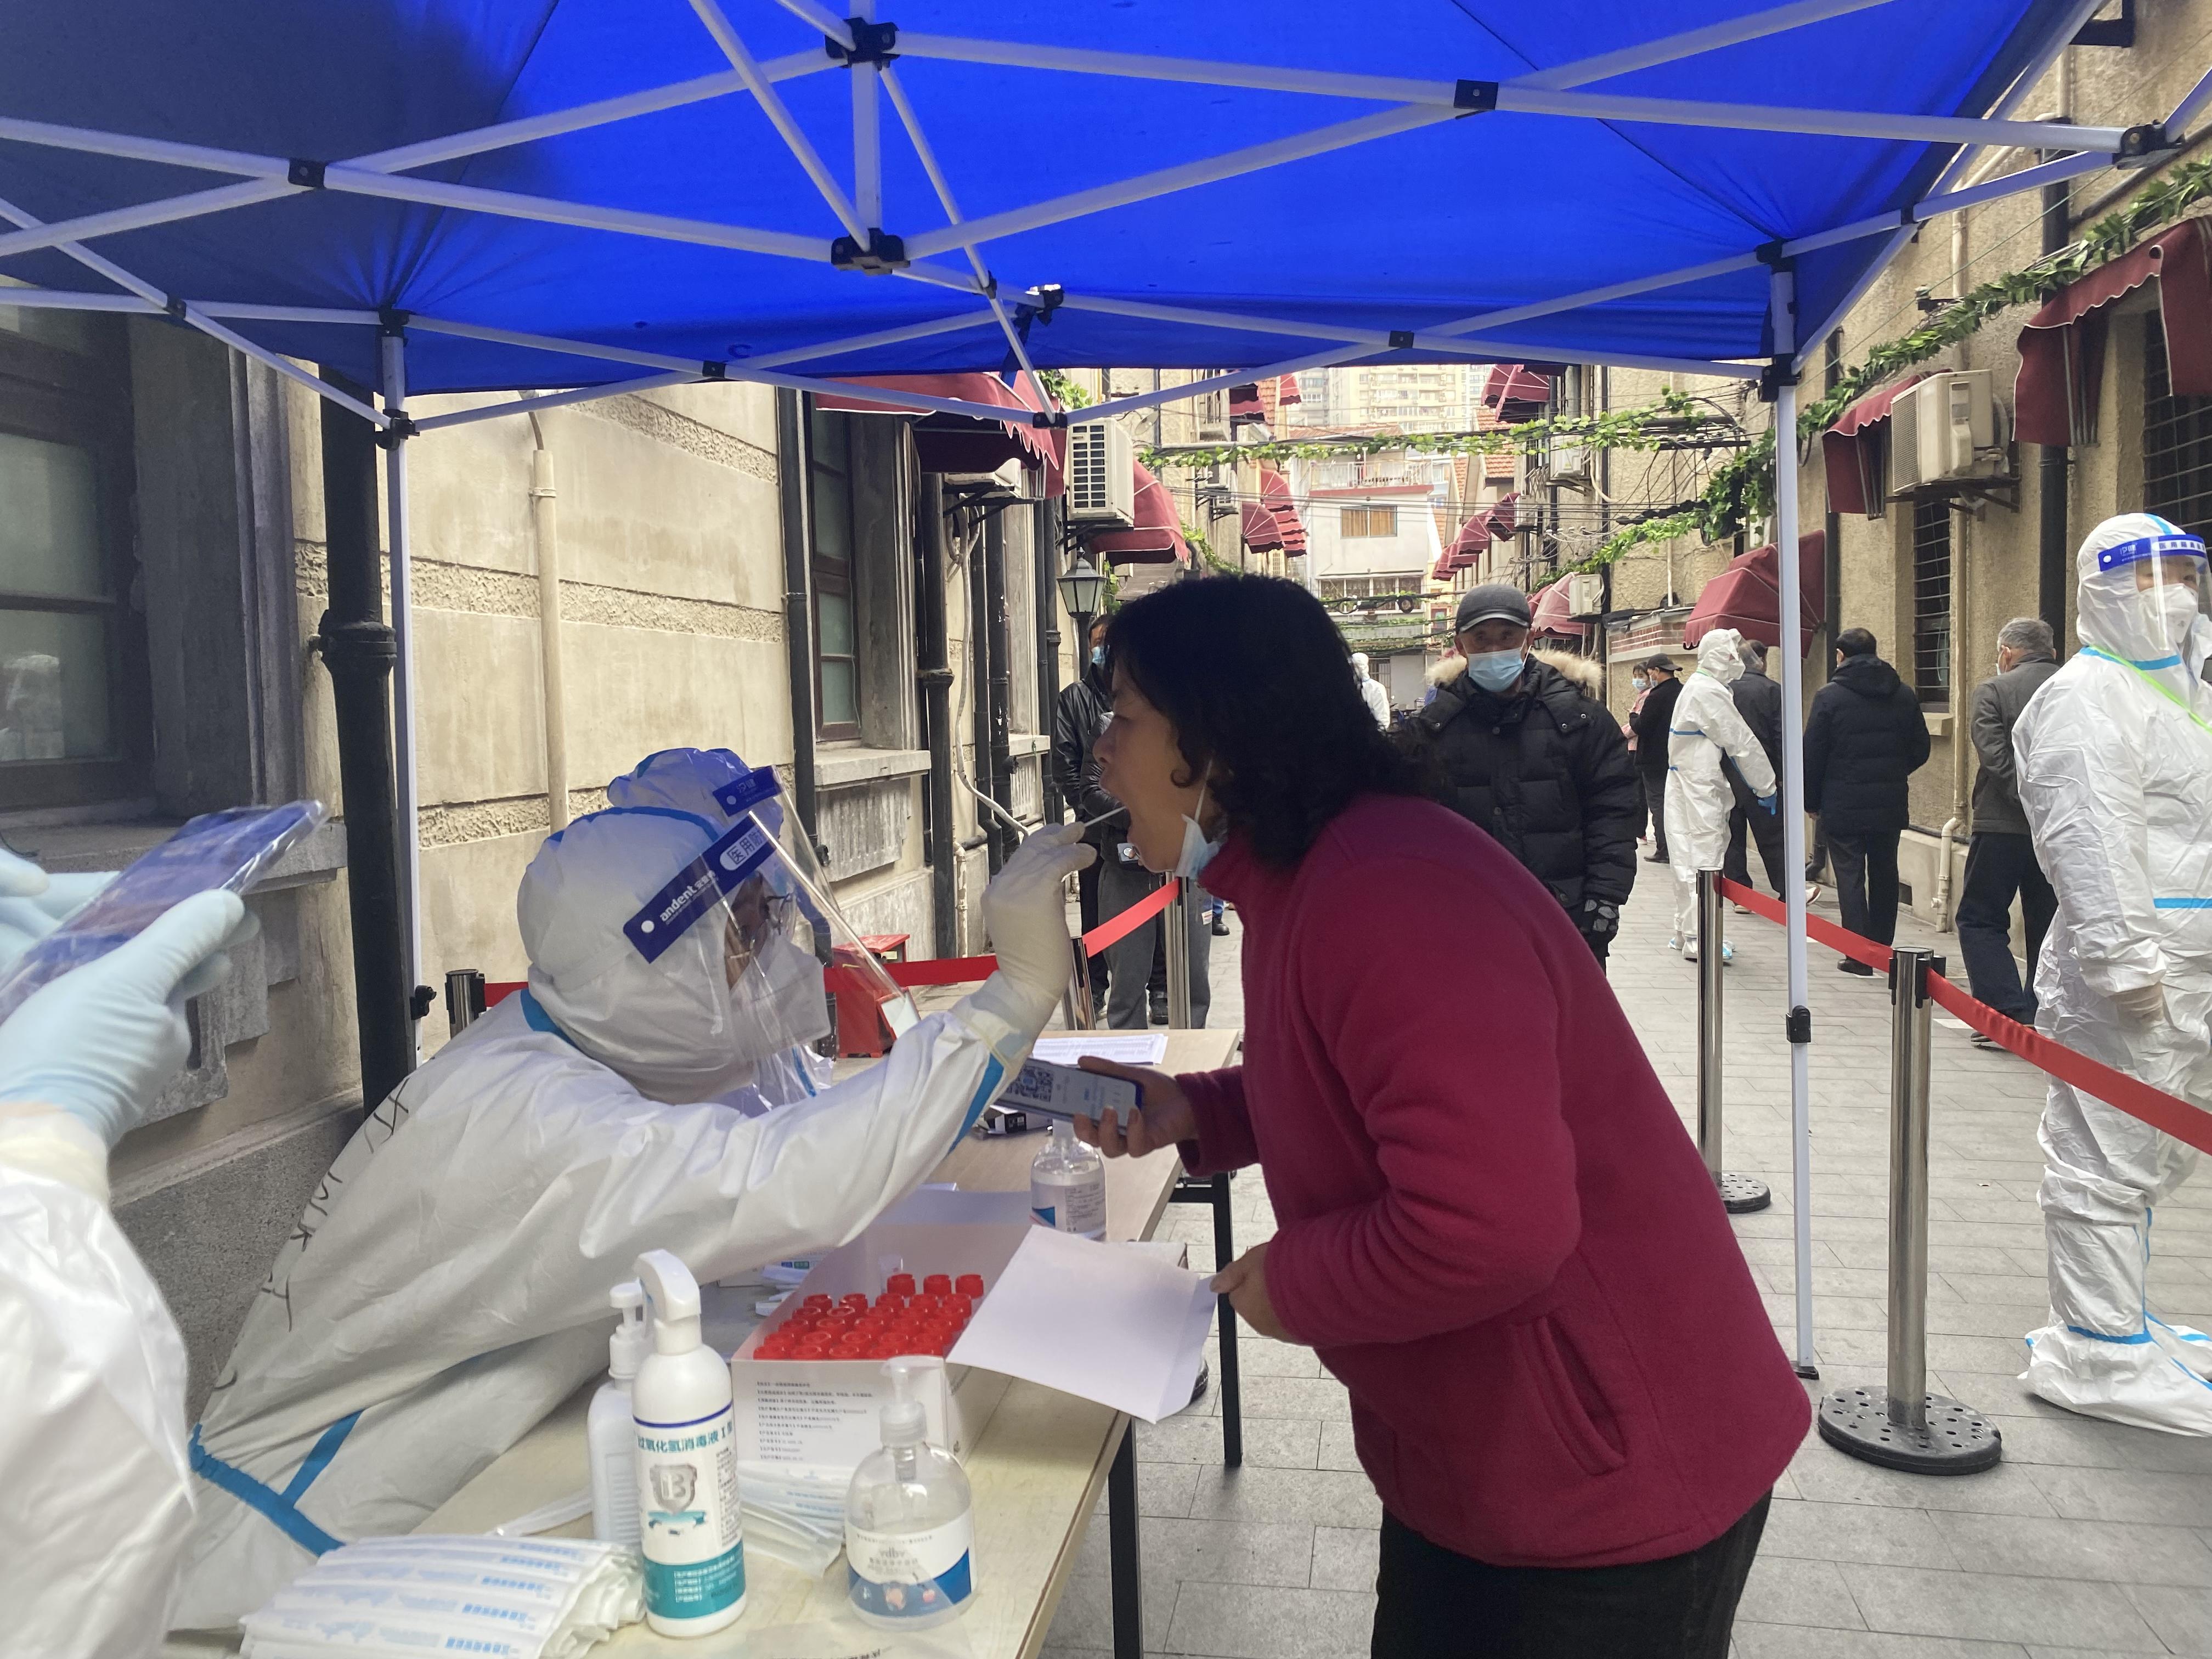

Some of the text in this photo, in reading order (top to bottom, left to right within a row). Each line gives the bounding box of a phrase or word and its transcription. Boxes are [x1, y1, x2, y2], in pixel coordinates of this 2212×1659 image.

[726, 829, 769, 865] 医用防
[659, 884, 697, 922] andent
